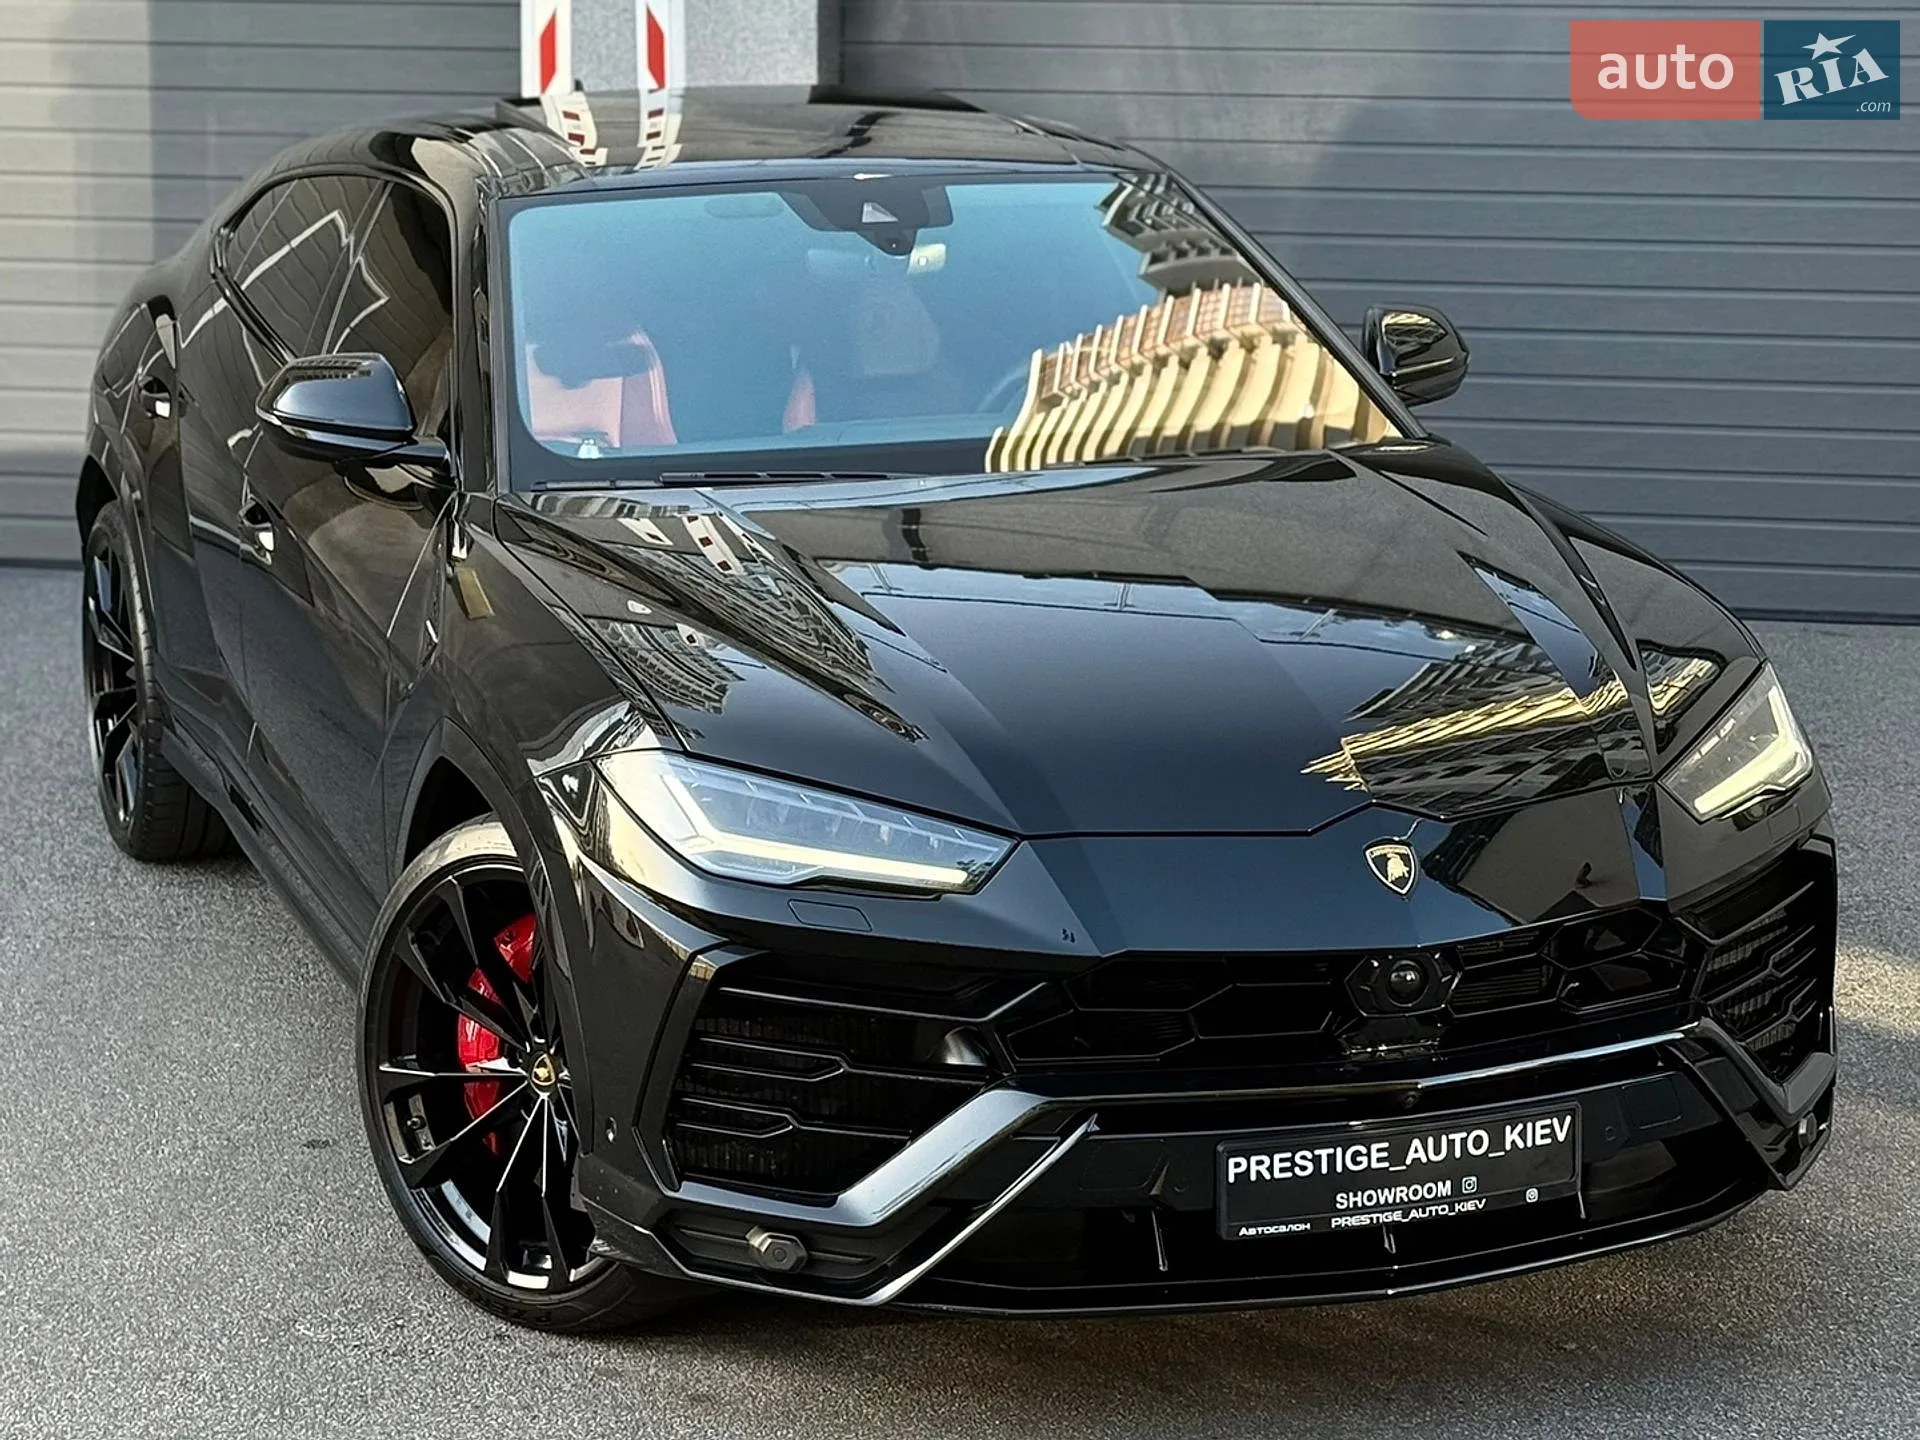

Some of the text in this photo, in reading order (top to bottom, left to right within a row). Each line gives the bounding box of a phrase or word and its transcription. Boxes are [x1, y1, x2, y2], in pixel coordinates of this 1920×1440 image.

[1227, 1114, 1572, 1183] PRESTIGE_AUTO_KIEV
[1335, 1180, 1452, 1210] SHOWROOM
[1331, 1199, 1486, 1229] PRESTIGE_AUTO_KIEV
